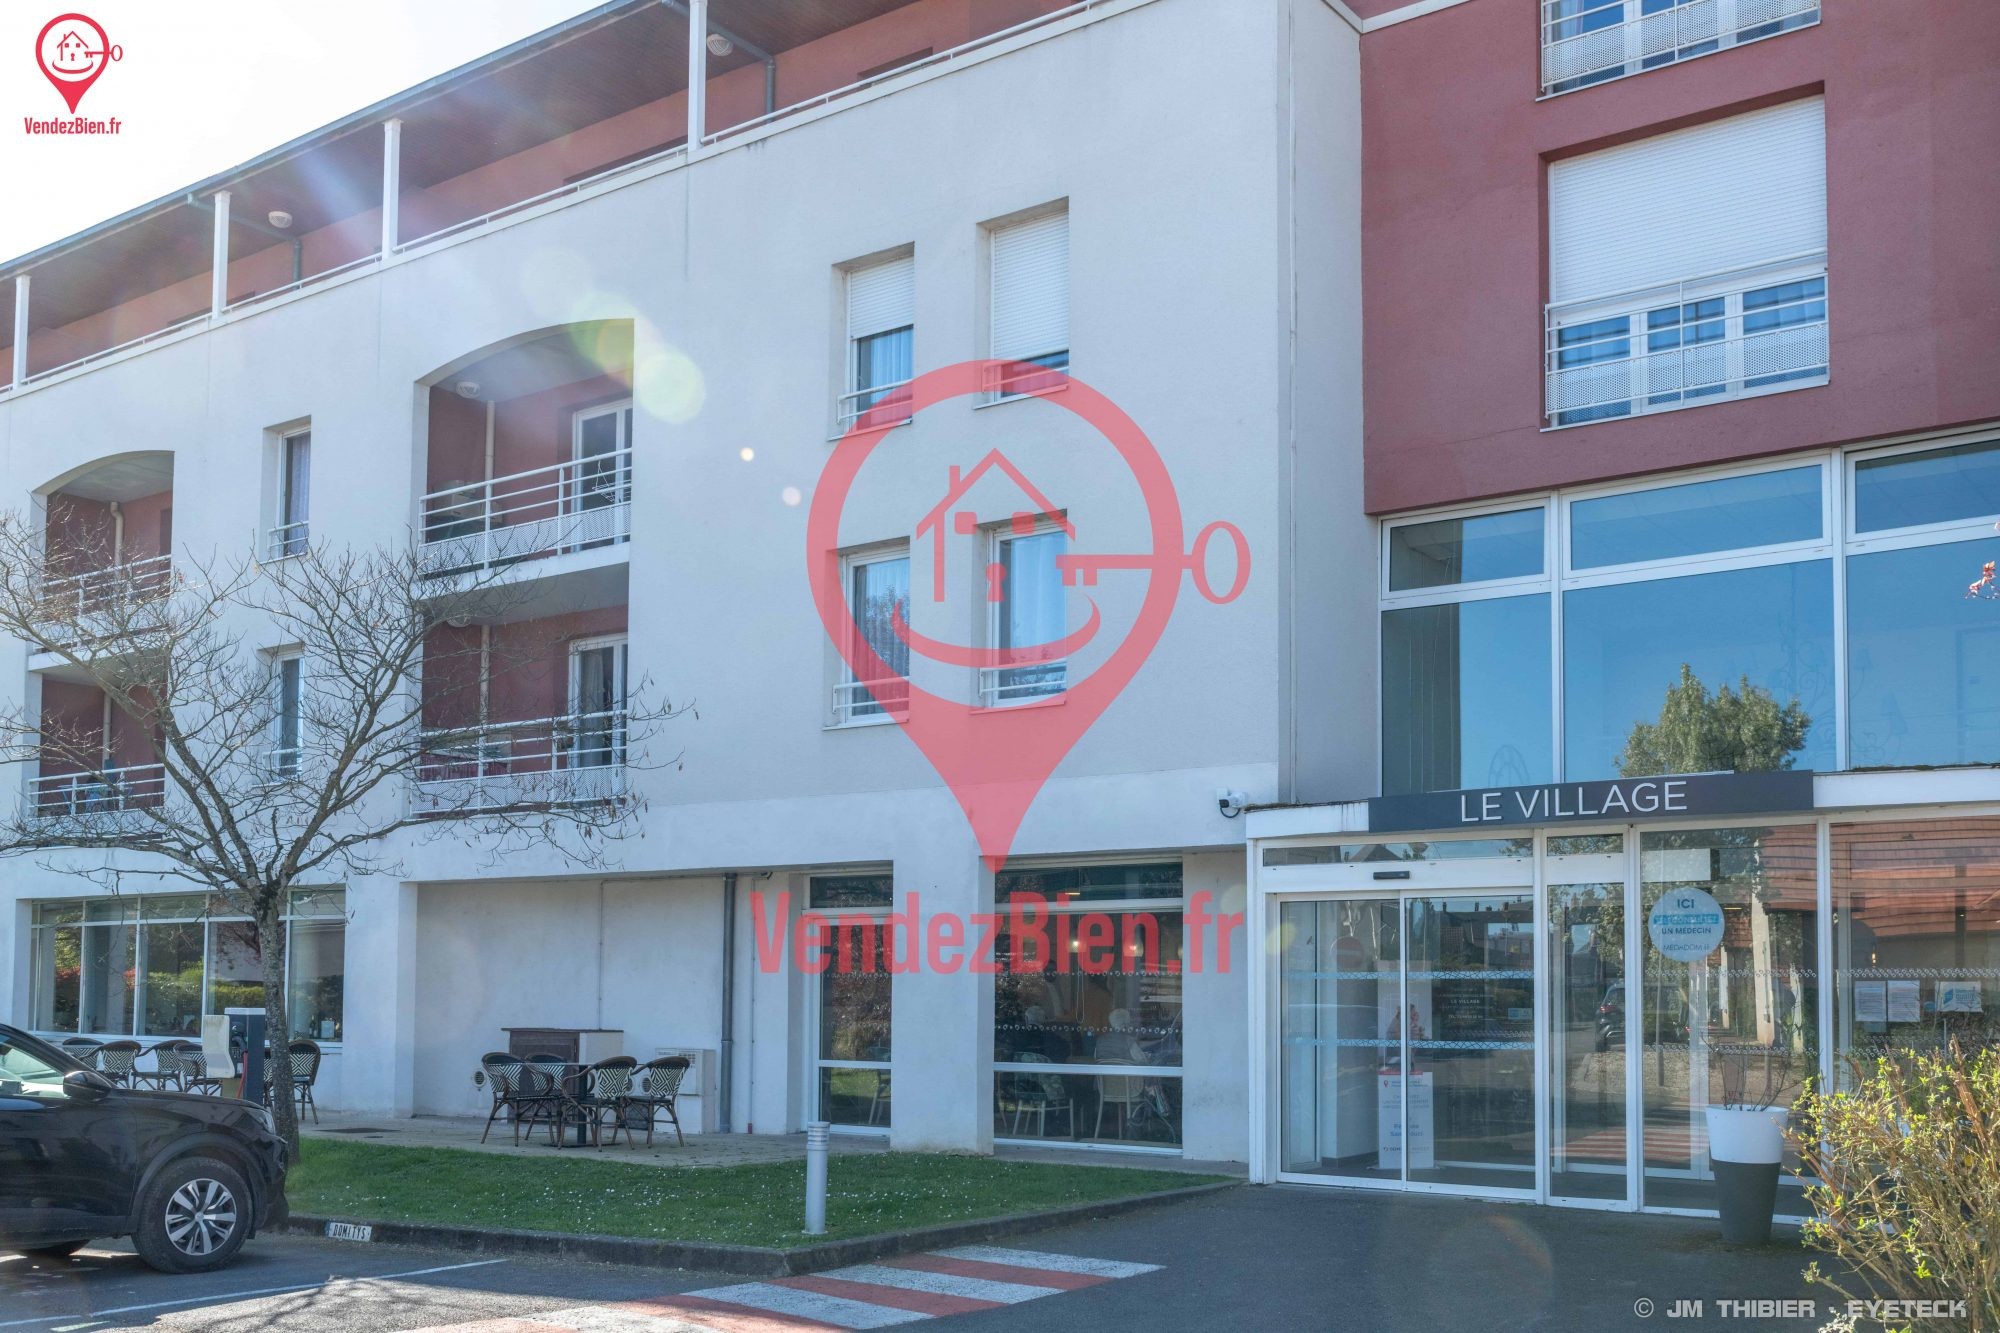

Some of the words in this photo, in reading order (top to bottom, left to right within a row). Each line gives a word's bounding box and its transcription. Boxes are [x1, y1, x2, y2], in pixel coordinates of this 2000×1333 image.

[1461, 792, 1503, 822] LE
[1516, 781, 1688, 818] VILLAGE
[1677, 899, 1695, 909] ICI
[333, 1224, 366, 1239] DOMITYS
